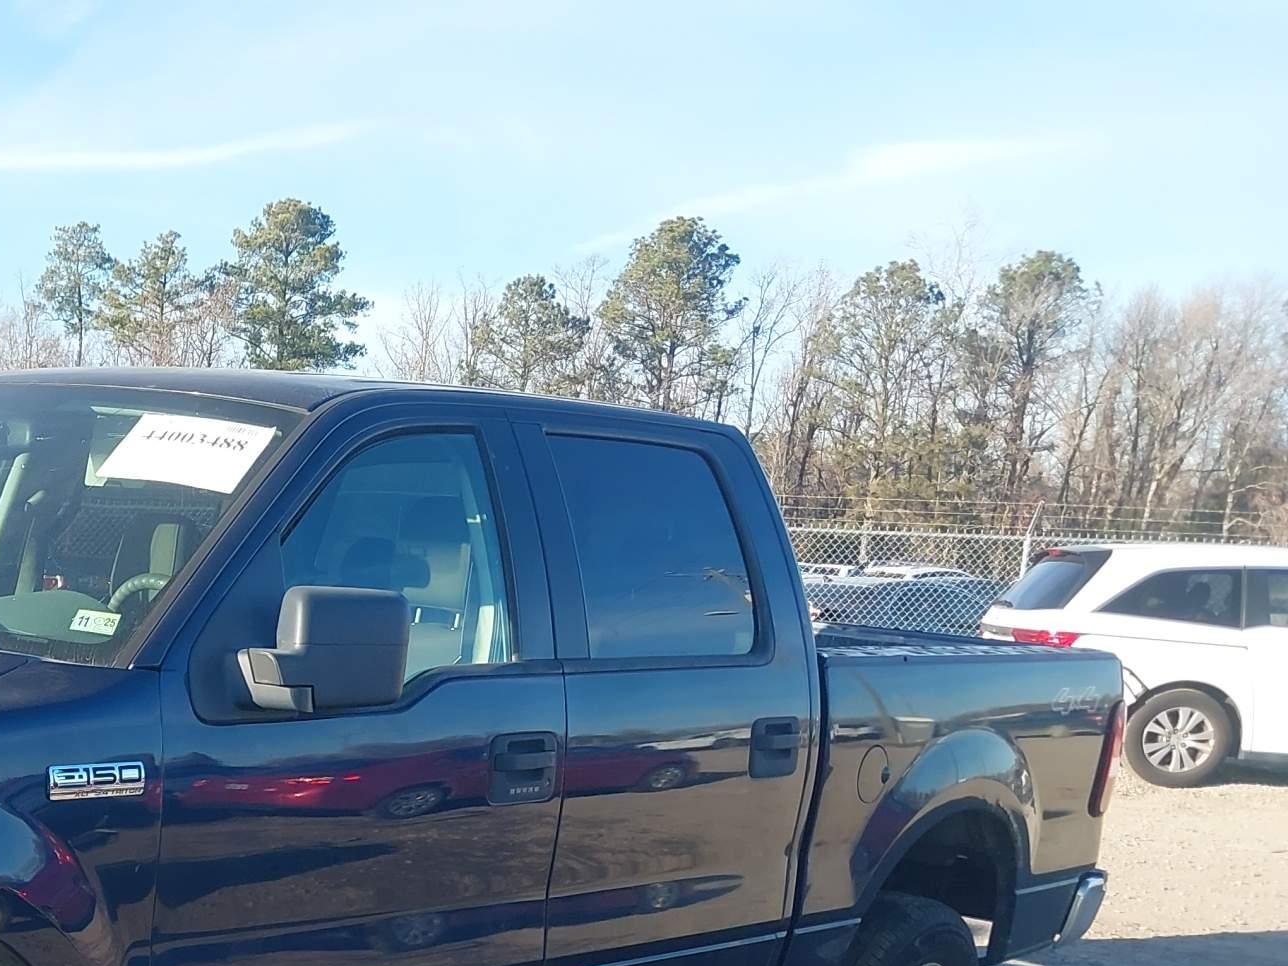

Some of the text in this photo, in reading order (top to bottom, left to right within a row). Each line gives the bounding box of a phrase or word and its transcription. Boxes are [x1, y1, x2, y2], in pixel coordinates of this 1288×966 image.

[142, 430, 249, 452] 44003488
[78, 615, 118, 628] 11 25
